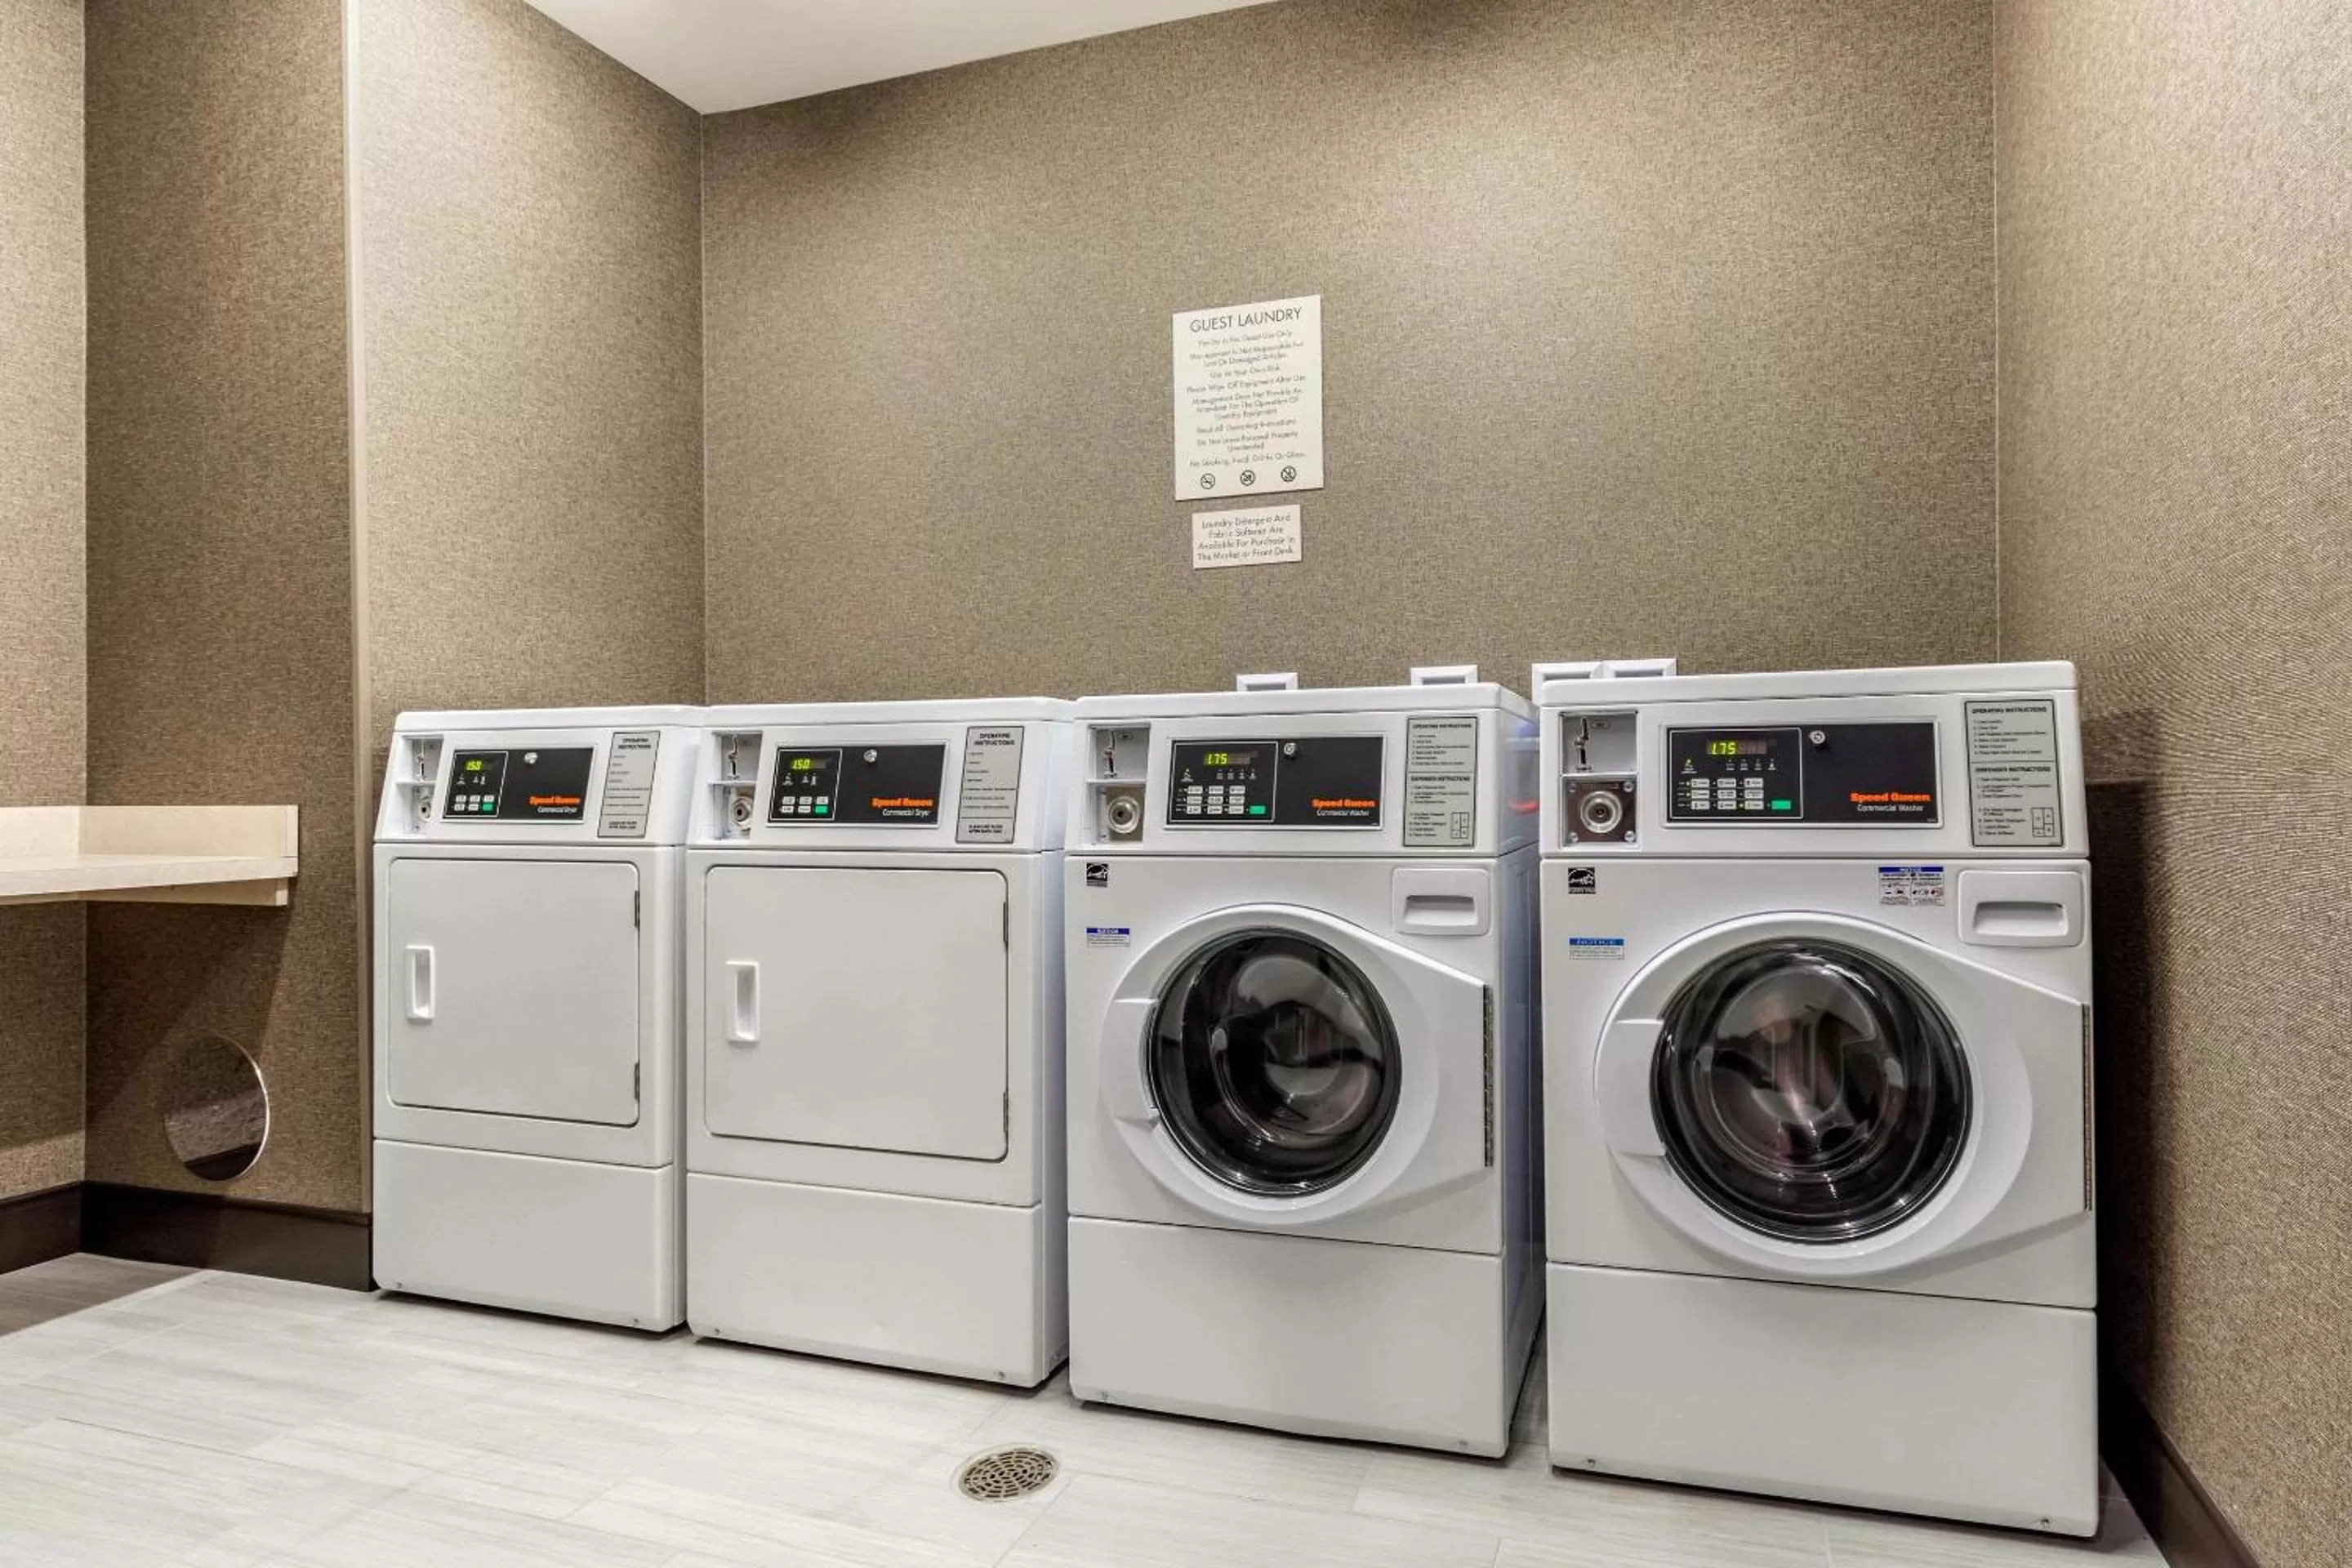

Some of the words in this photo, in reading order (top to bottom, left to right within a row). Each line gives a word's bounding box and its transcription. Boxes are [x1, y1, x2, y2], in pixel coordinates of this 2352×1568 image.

[1190, 315, 1233, 332] GUEST
[1238, 307, 1303, 327] LAUNDRY
[871, 797, 902, 808] Speed
[1850, 792, 1889, 804] Speed
[1891, 792, 1931, 803] Queen
[1312, 799, 1343, 809] Speed
[1344, 799, 1376, 808] Queen
